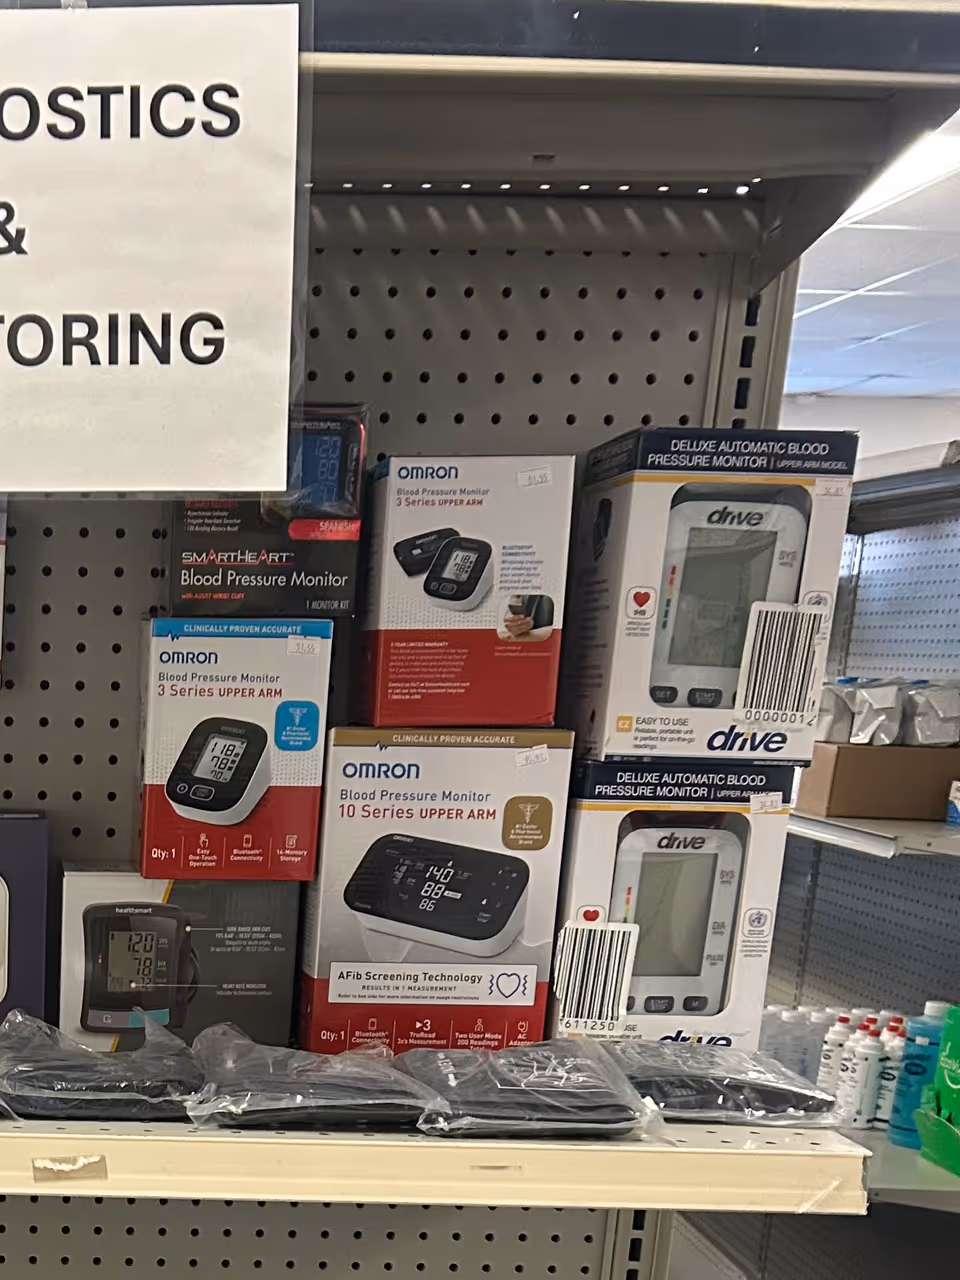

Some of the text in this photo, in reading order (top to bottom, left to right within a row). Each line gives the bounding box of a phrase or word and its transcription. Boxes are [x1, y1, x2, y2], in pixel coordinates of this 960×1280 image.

[671, 440, 829, 455] DELUXE AUTOMATIC BLOOD
[647, 455, 767, 468] PRESSURE MONITOR
[398, 466, 459, 480] OMRON
[397, 488, 490, 496] Blood Pressure Monitor
[396, 498, 402, 507] 3
[404, 497, 435, 507] Series
[707, 506, 764, 526] drive
[320, 521, 355, 530] SPANISH
[181, 568, 348, 586] Blood Pressure Monitor
[184, 625, 301, 634] CLINICALLY PROVEN ACCURATE
[160, 652, 218, 665] OMRON
[158, 672, 280, 683] Blood Pressure Monitor
[158, 684, 282, 698] 3 Series UPPER ARM
[636, 717, 689, 726] EASY TO USE
[393, 735, 515, 744] CLINICALLY PROVEN ACCURATE
[706, 724, 788, 753] drive
[342, 762, 420, 779] OMRON
[617, 772, 766, 786] DELUXE AUTOMATIC BLOOD
[340, 789, 491, 802] Blood Pressure Monitor
[595, 785, 708, 797] PRESSURE MONITOR
[339, 804, 496, 820] 10 Series UPPER ARM
[657, 832, 706, 850] drive
[338, 971, 483, 984] AFib Screening Technology
[564, 1019, 615, 1031] 611250
[321, 1030, 344, 1041] Qty: 1
